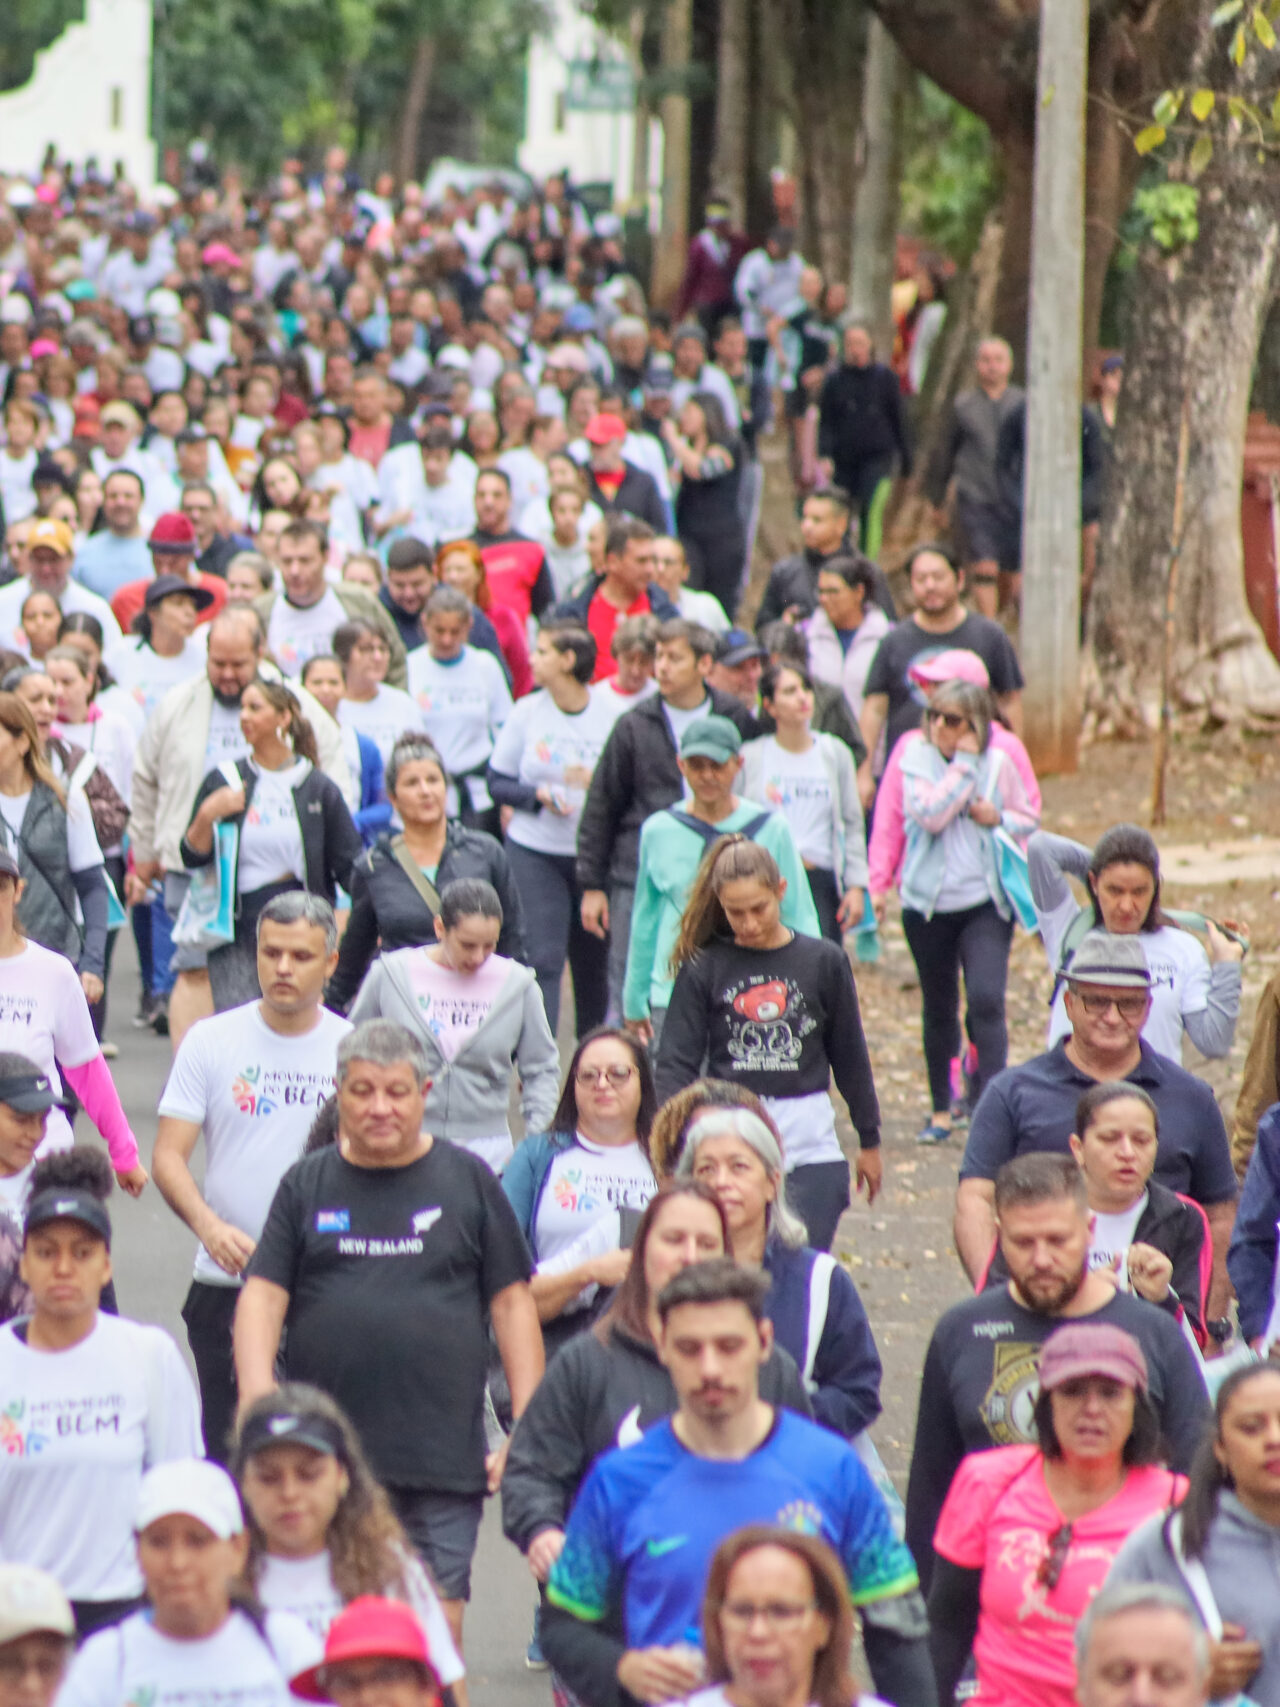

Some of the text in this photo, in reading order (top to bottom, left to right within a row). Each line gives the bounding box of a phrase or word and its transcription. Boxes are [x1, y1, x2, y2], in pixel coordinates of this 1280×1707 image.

[338, 1237, 424, 1257] NEW ZEALAND
[29, 1394, 123, 1413] MOVIMENTO
[56, 1412, 119, 1436] BEM
